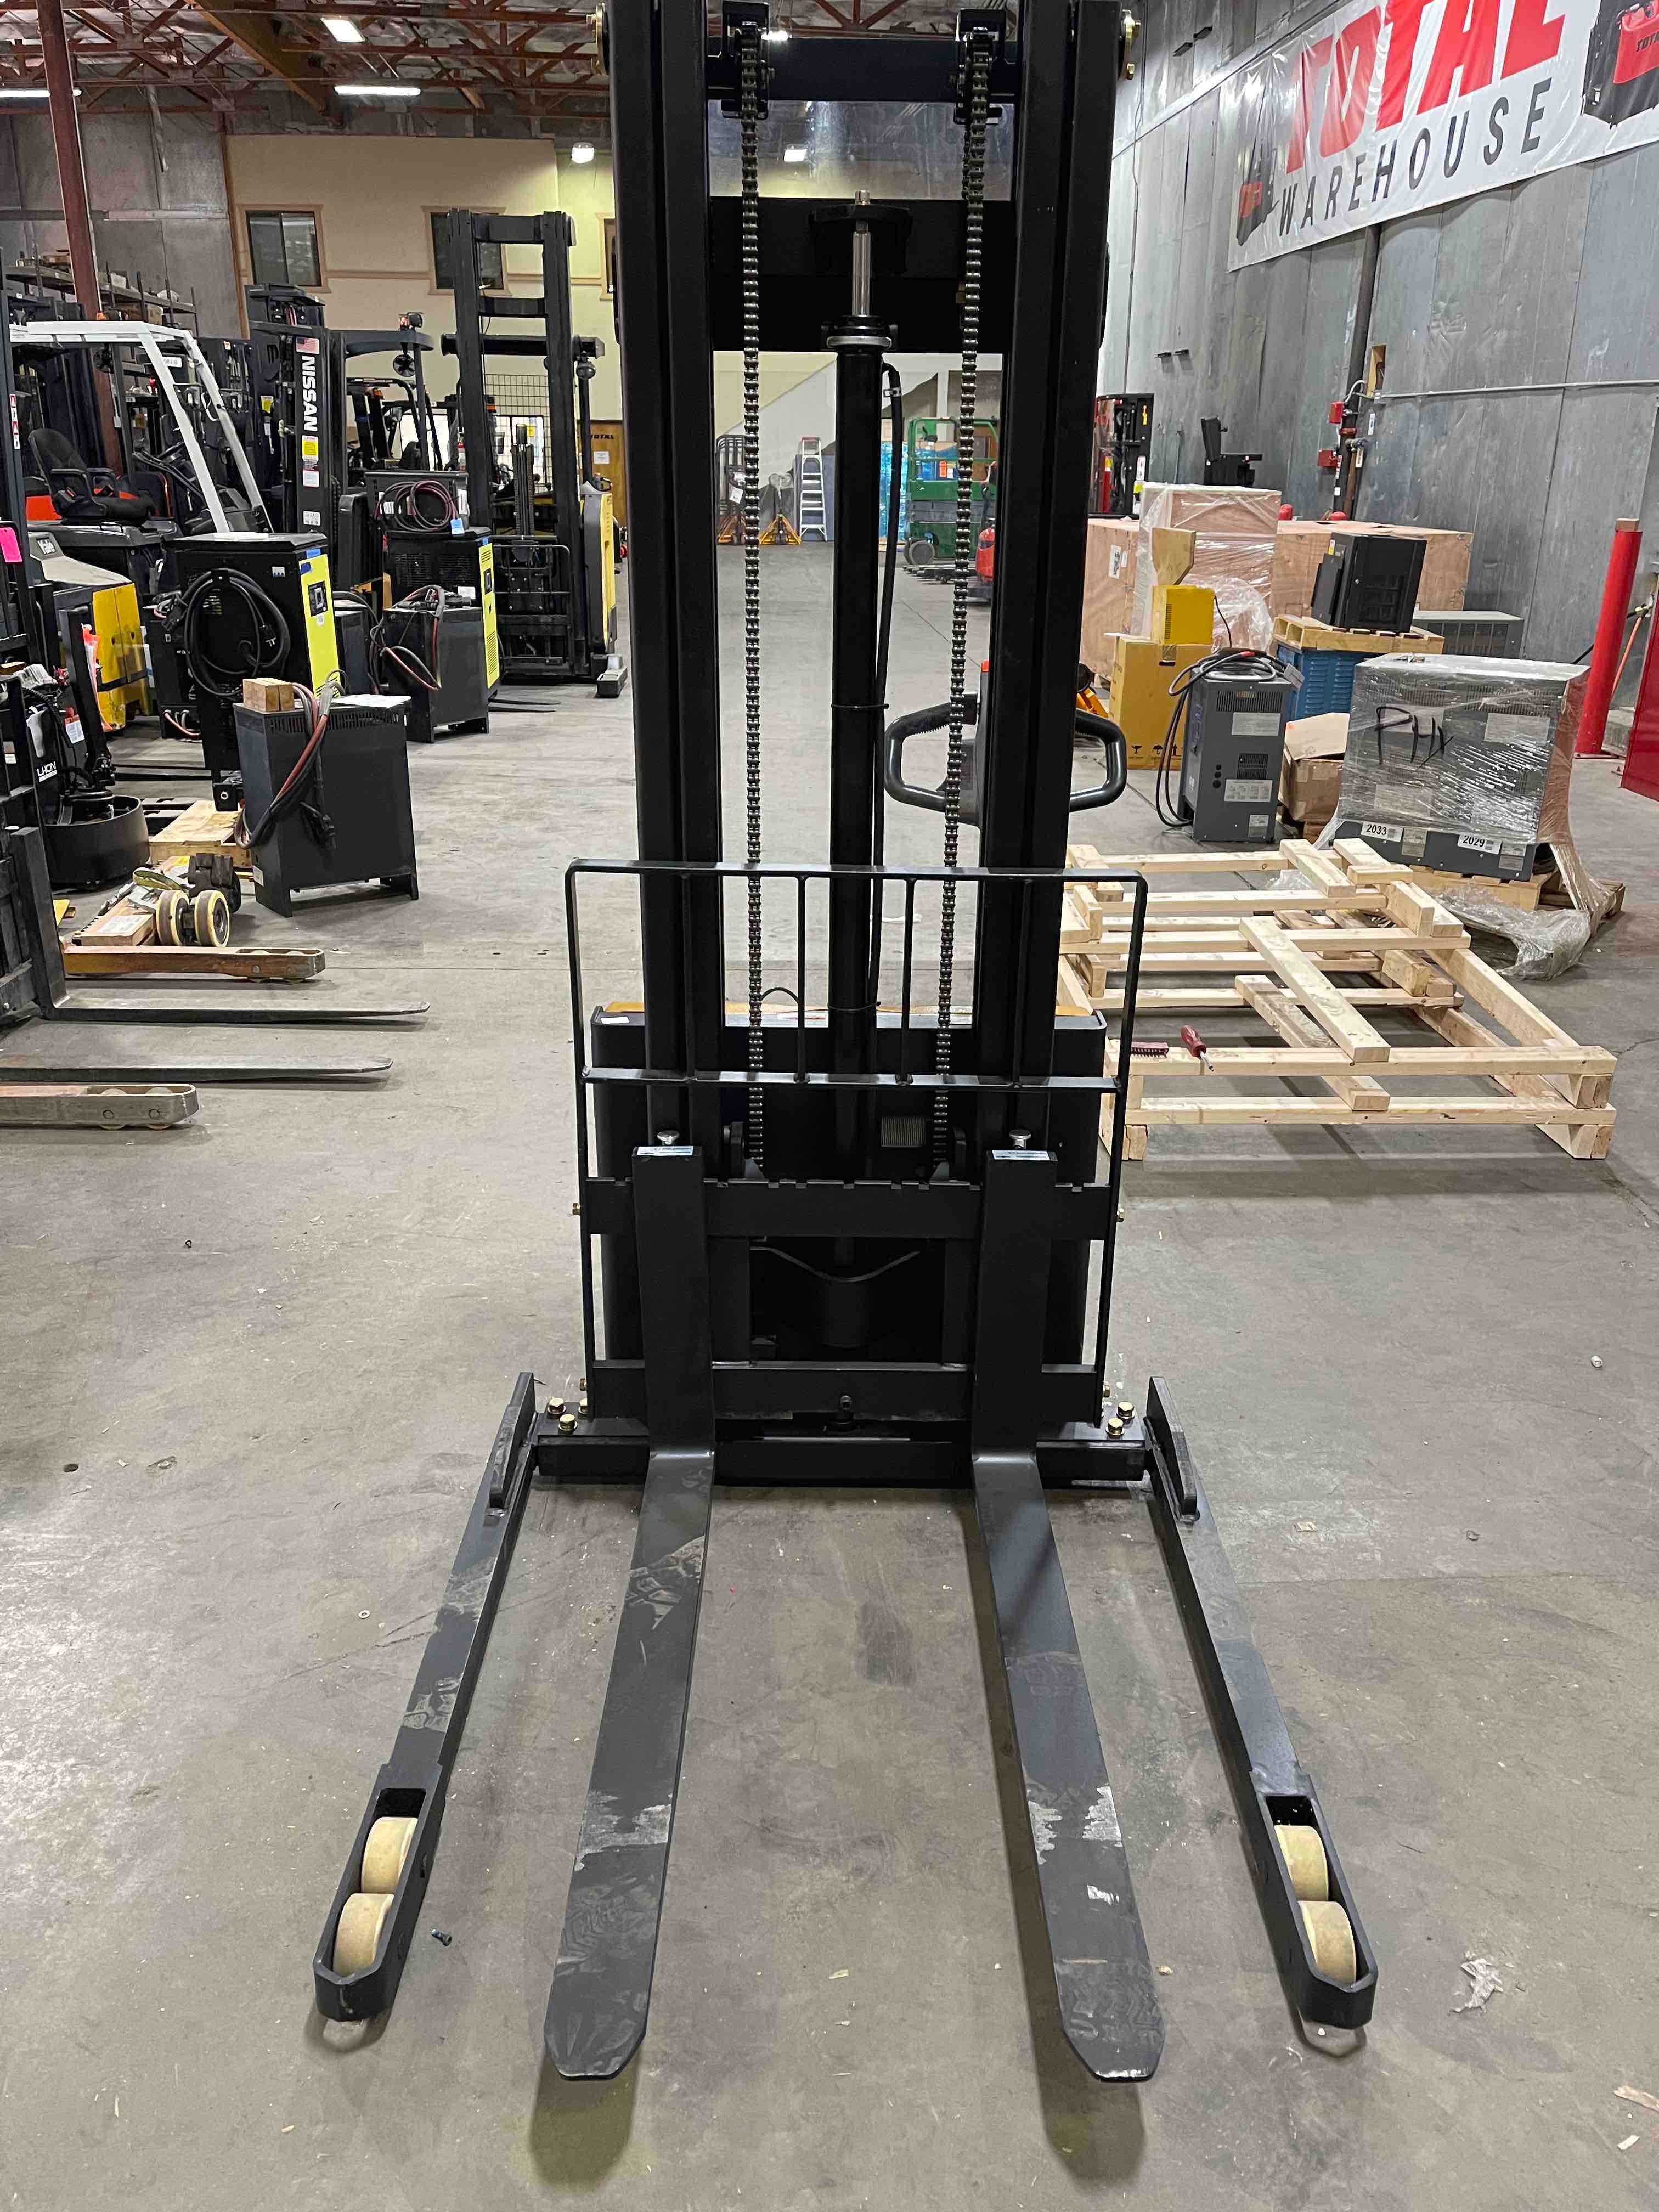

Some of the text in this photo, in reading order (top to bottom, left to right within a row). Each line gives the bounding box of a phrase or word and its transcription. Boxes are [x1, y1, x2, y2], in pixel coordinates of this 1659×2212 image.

[1279, 77, 1552, 237] WAREHOUSE
[302, 356, 318, 432] NISSAN
[37, 539, 55, 554] Yale
[1365, 823, 1387, 836] 2033
[1462, 835, 1485, 847] 2029
